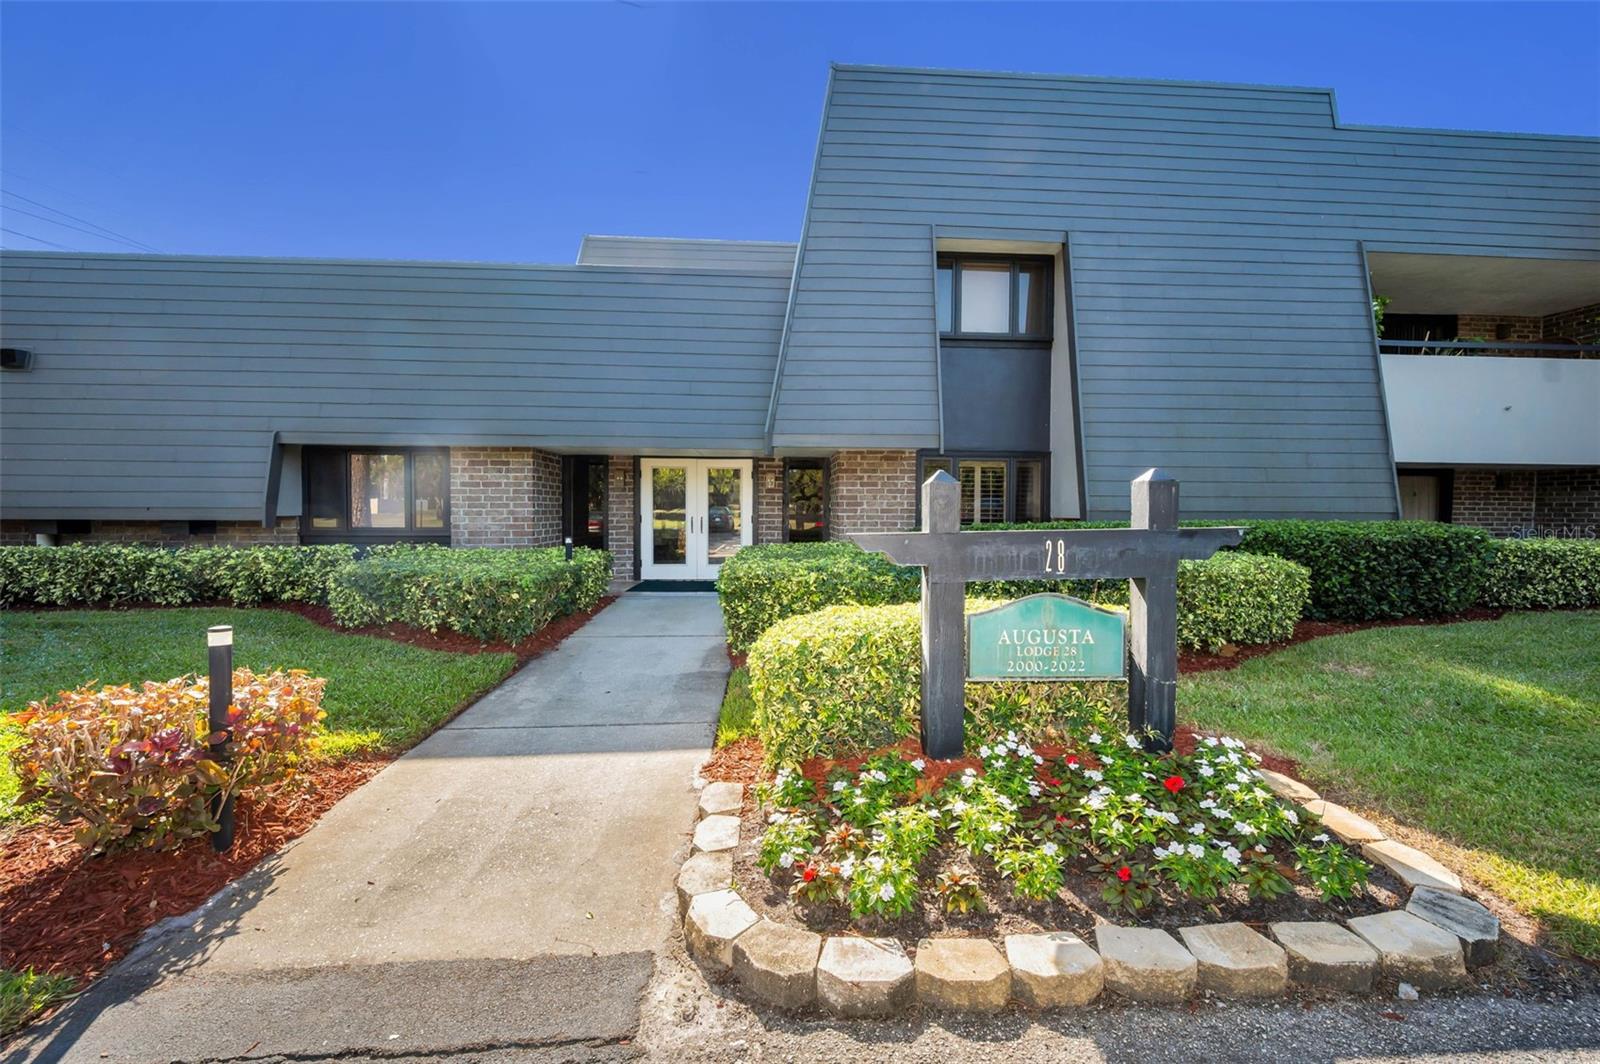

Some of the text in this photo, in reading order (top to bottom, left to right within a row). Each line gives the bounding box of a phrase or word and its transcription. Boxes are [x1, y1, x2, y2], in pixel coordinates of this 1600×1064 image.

[1045, 539, 1065, 572] 28
[998, 629, 1095, 645] AUGUSTA
[1016, 646, 1078, 657] LODGE 28
[1007, 660, 1086, 673] 2000-2022
